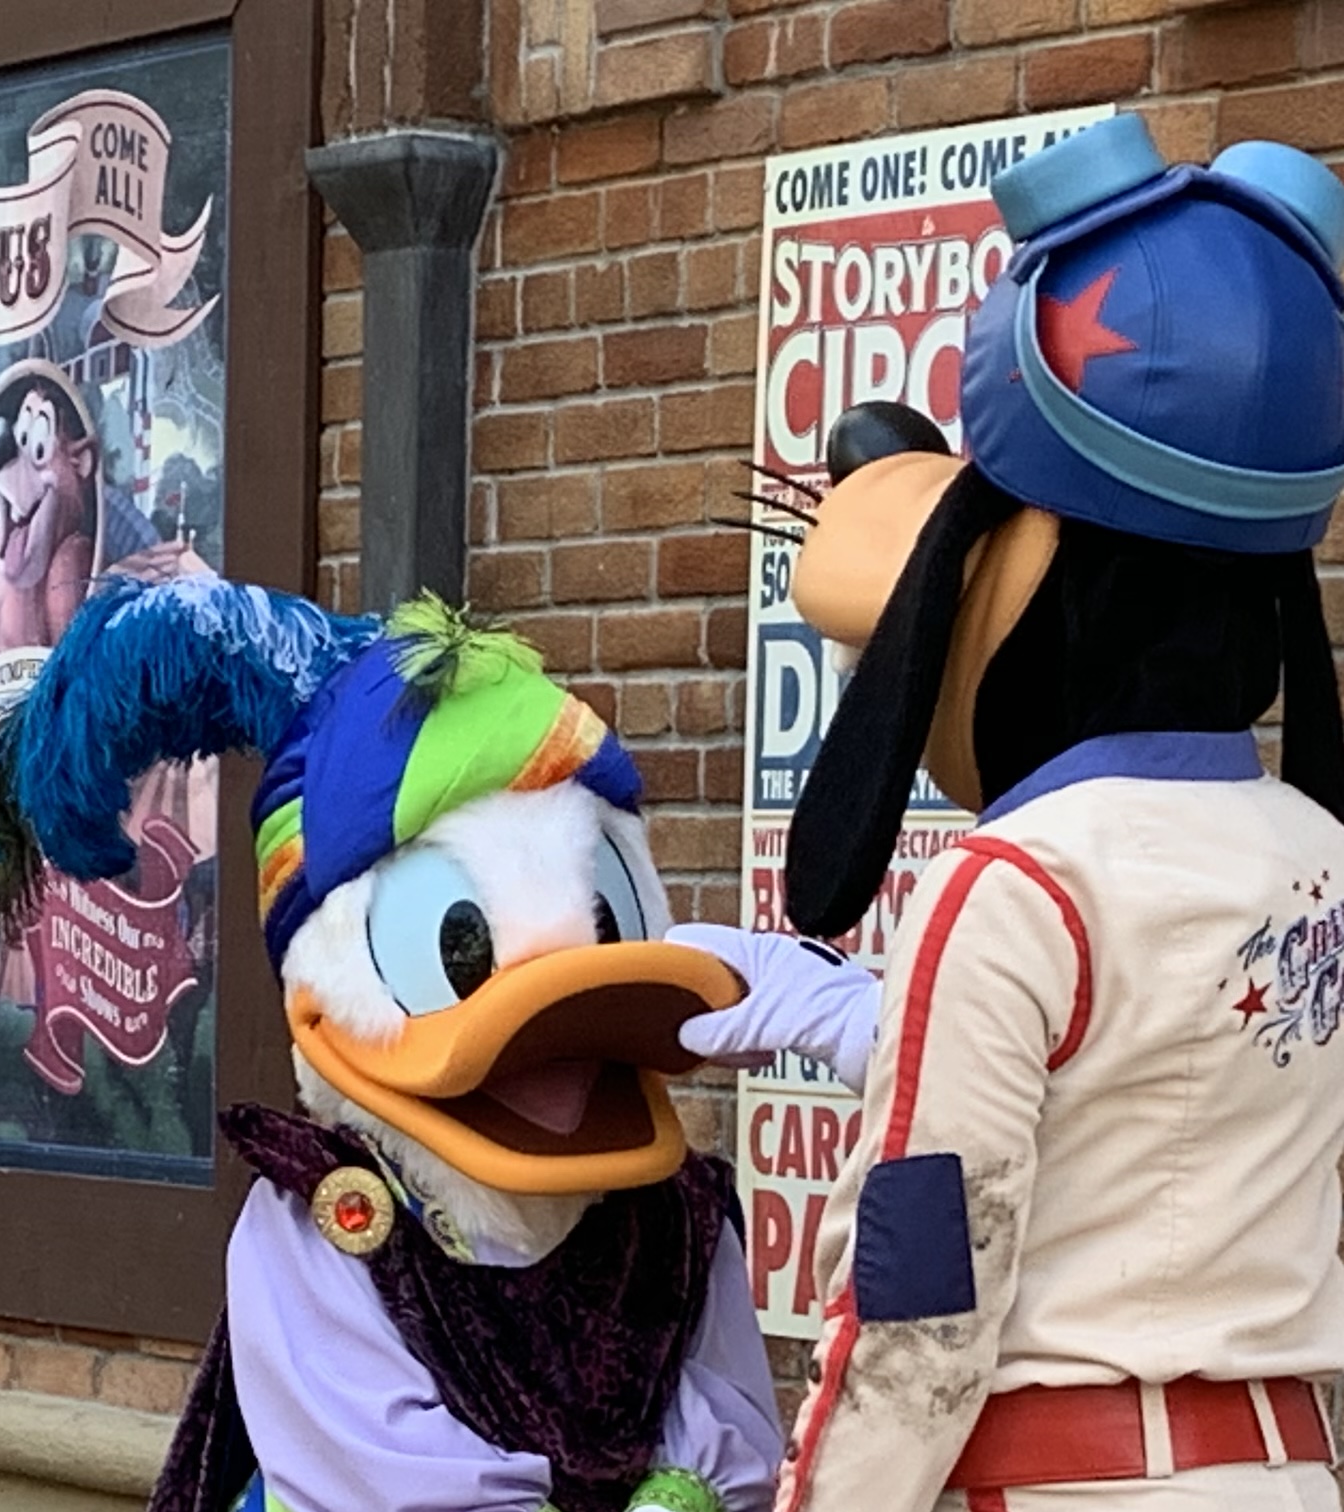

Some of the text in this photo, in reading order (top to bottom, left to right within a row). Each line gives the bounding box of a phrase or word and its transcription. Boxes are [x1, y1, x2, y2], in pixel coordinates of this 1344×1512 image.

[90, 123, 149, 173] COME
[95, 165, 143, 221] ALL!
[776, 160, 850, 214] COME
[861, 146, 927, 202] ONE!
[771, 228, 1018, 328] STORYBO
[766, 312, 965, 467] CIRC
[760, 768, 794, 800] THE
[752, 827, 787, 858] WIT
[51, 915, 159, 1004] INCREDIBLE
